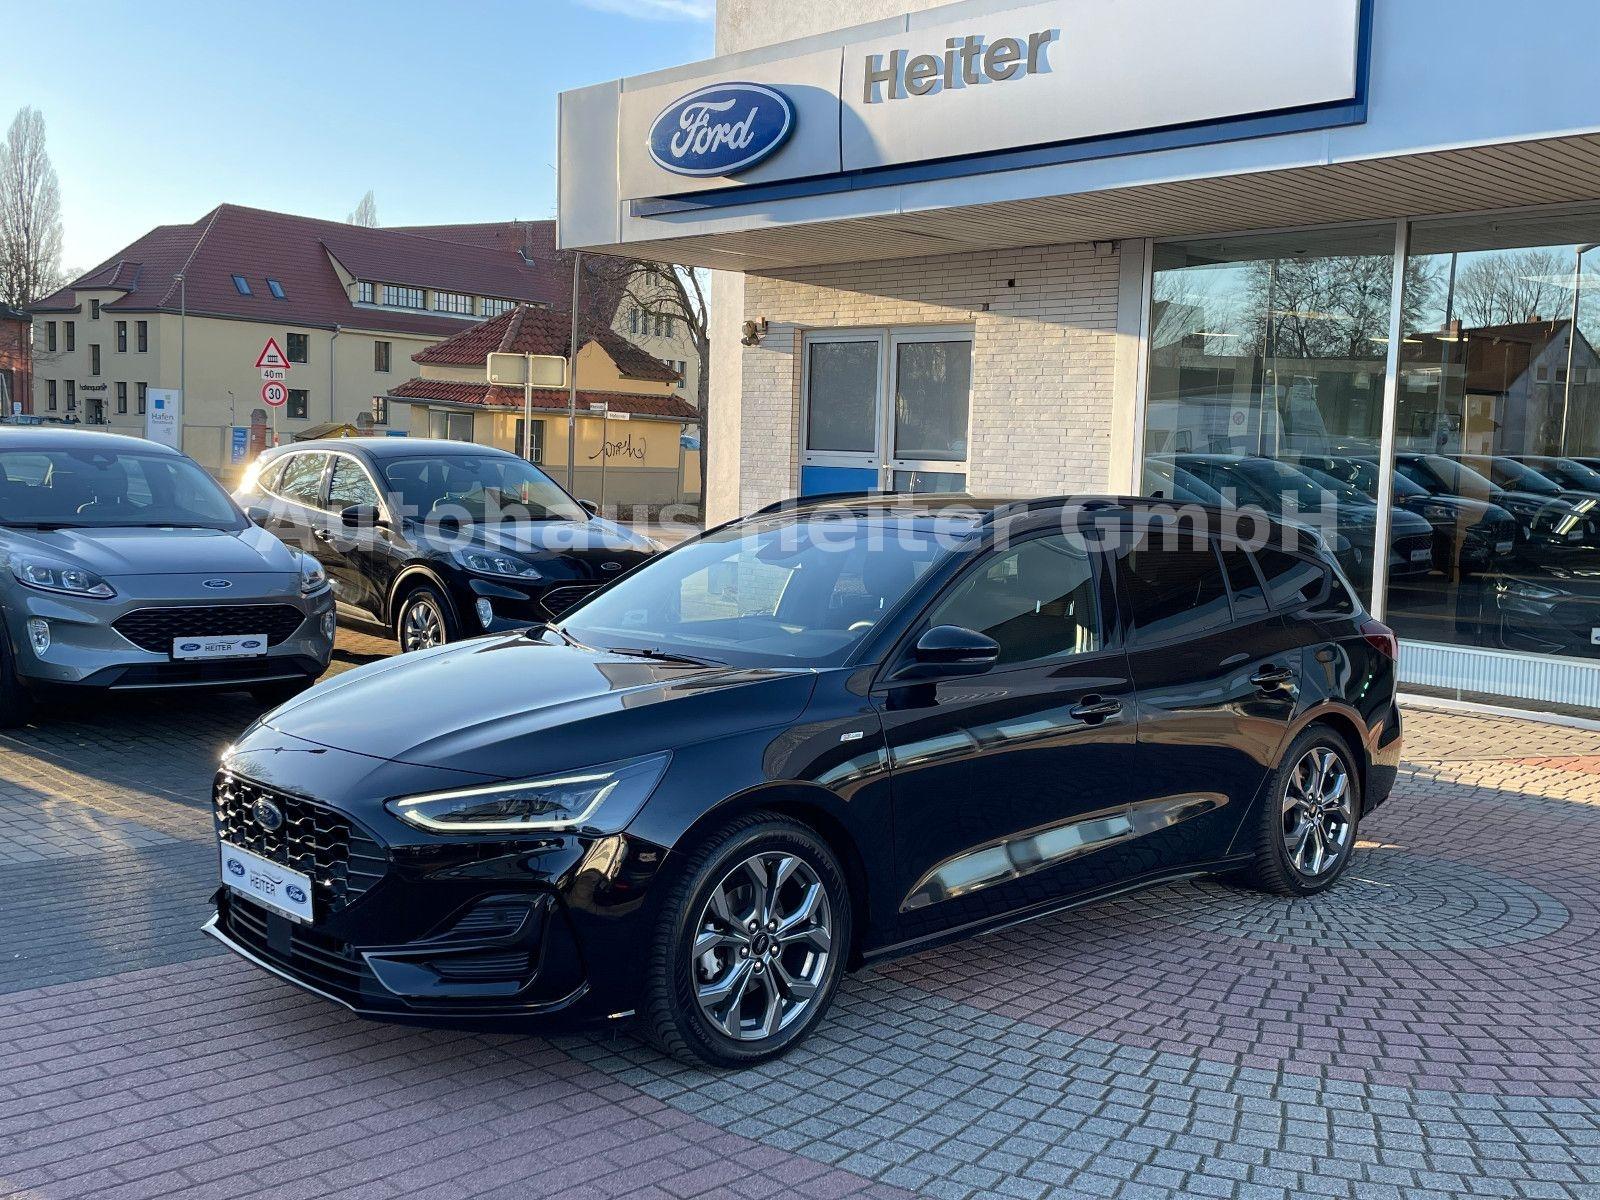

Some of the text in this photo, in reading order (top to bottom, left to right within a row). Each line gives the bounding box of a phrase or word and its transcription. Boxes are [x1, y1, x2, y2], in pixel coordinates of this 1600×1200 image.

[864, 29, 1051, 104] Heiter
[671, 98, 754, 158] Ford
[268, 388, 281, 400] 30
[205, 644, 232, 652] HEITER
[250, 873, 277, 896] HEITER
